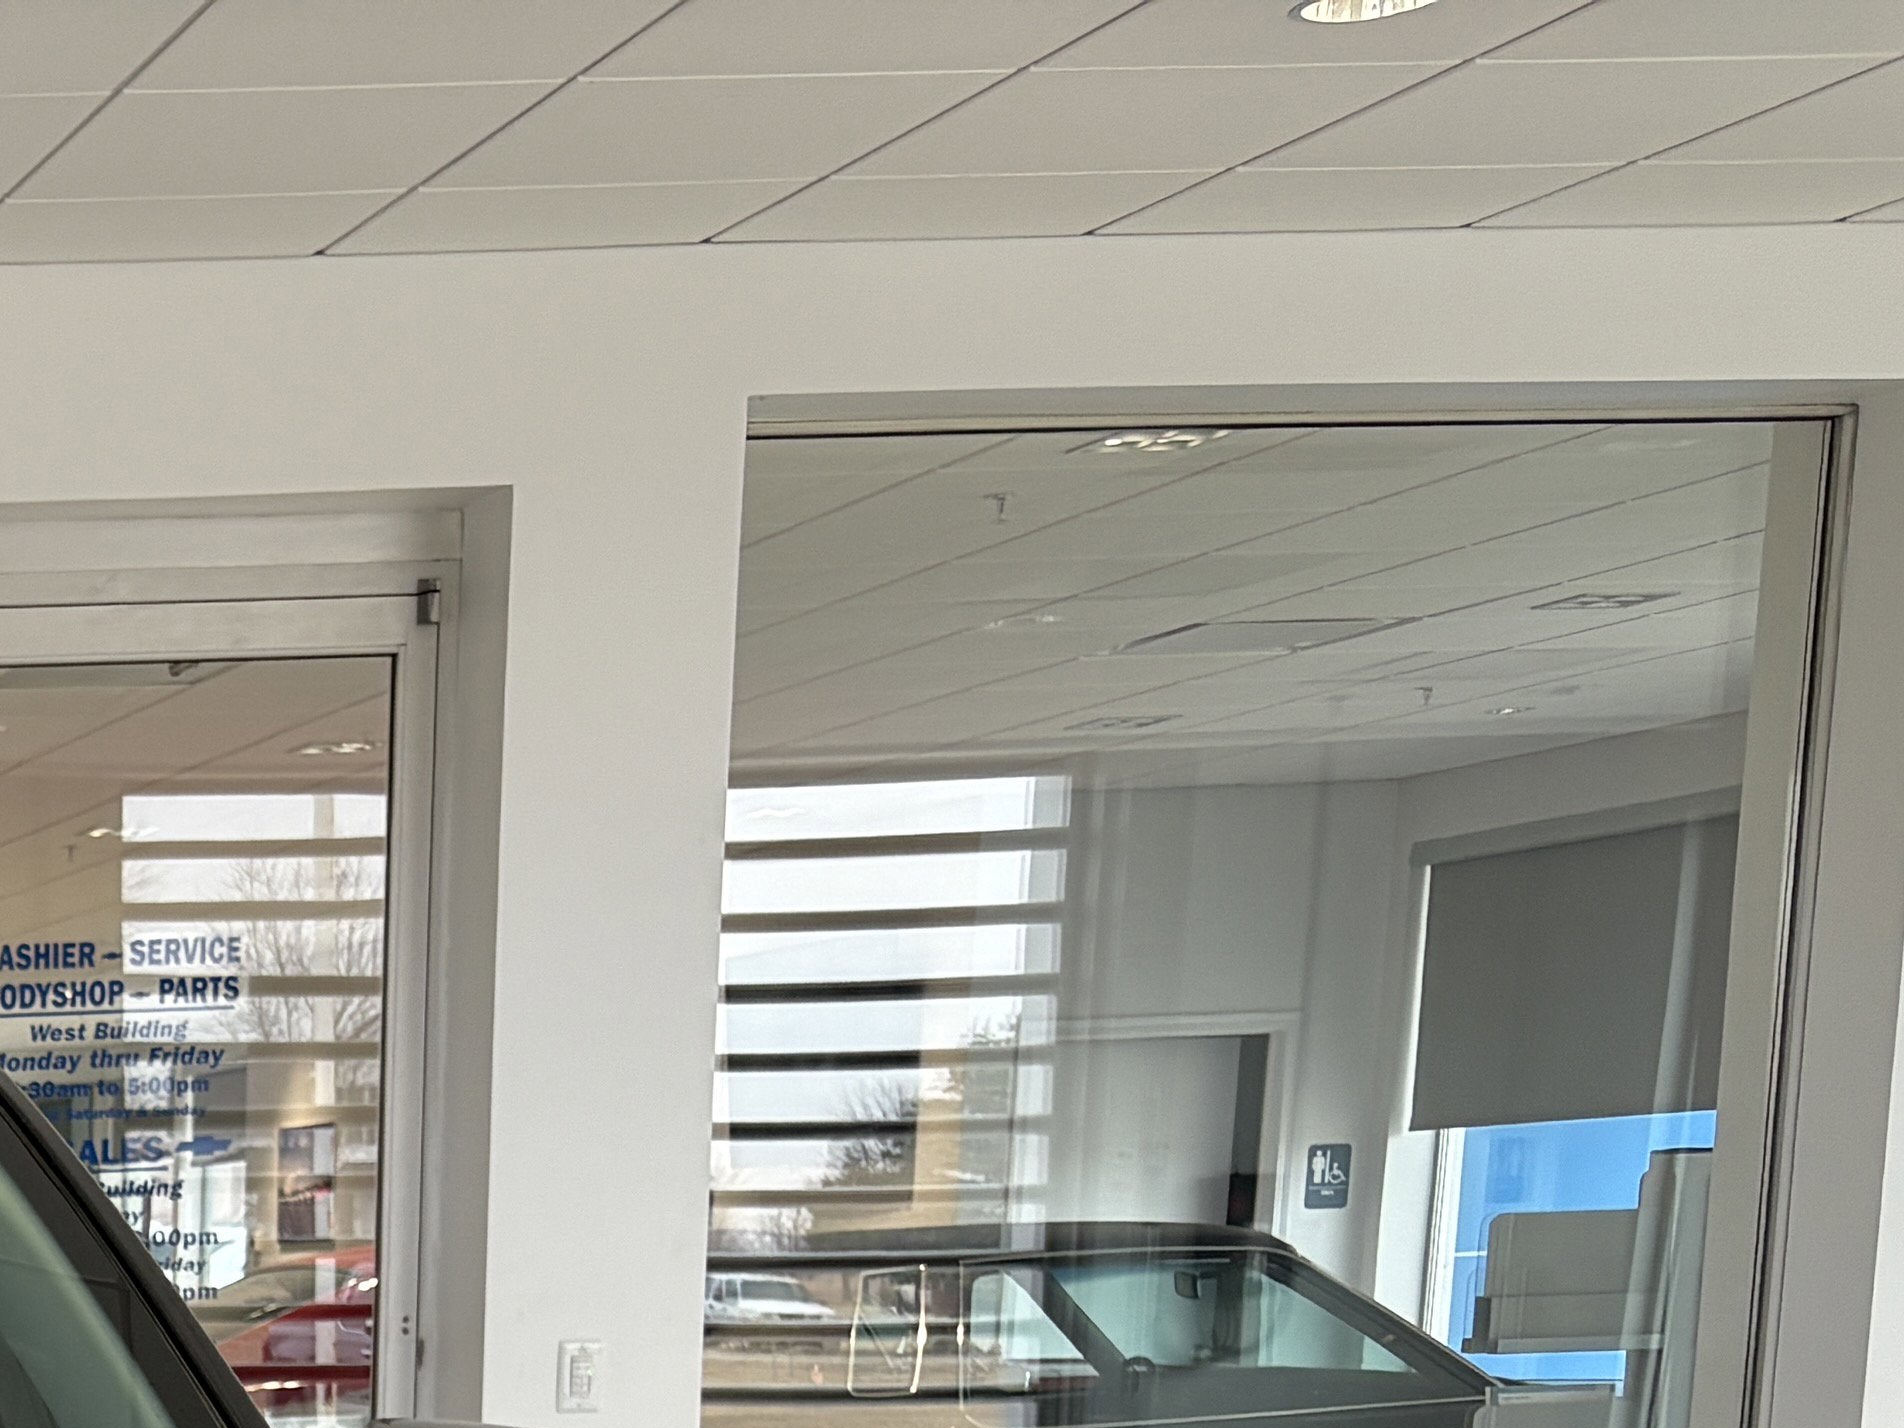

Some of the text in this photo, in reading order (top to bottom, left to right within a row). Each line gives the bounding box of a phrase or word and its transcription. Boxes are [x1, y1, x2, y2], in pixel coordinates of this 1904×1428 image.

[130, 937, 241, 966] SERVICE
[159, 976, 239, 1004] PARTS
[30, 1020, 189, 1042] West Building
[90, 1049, 139, 1068] thru
[147, 1046, 224, 1068] Friday
[97, 1078, 120, 1096] to
[128, 1077, 209, 1097] 5:00pm
[70, 1136, 164, 1165] ALES
